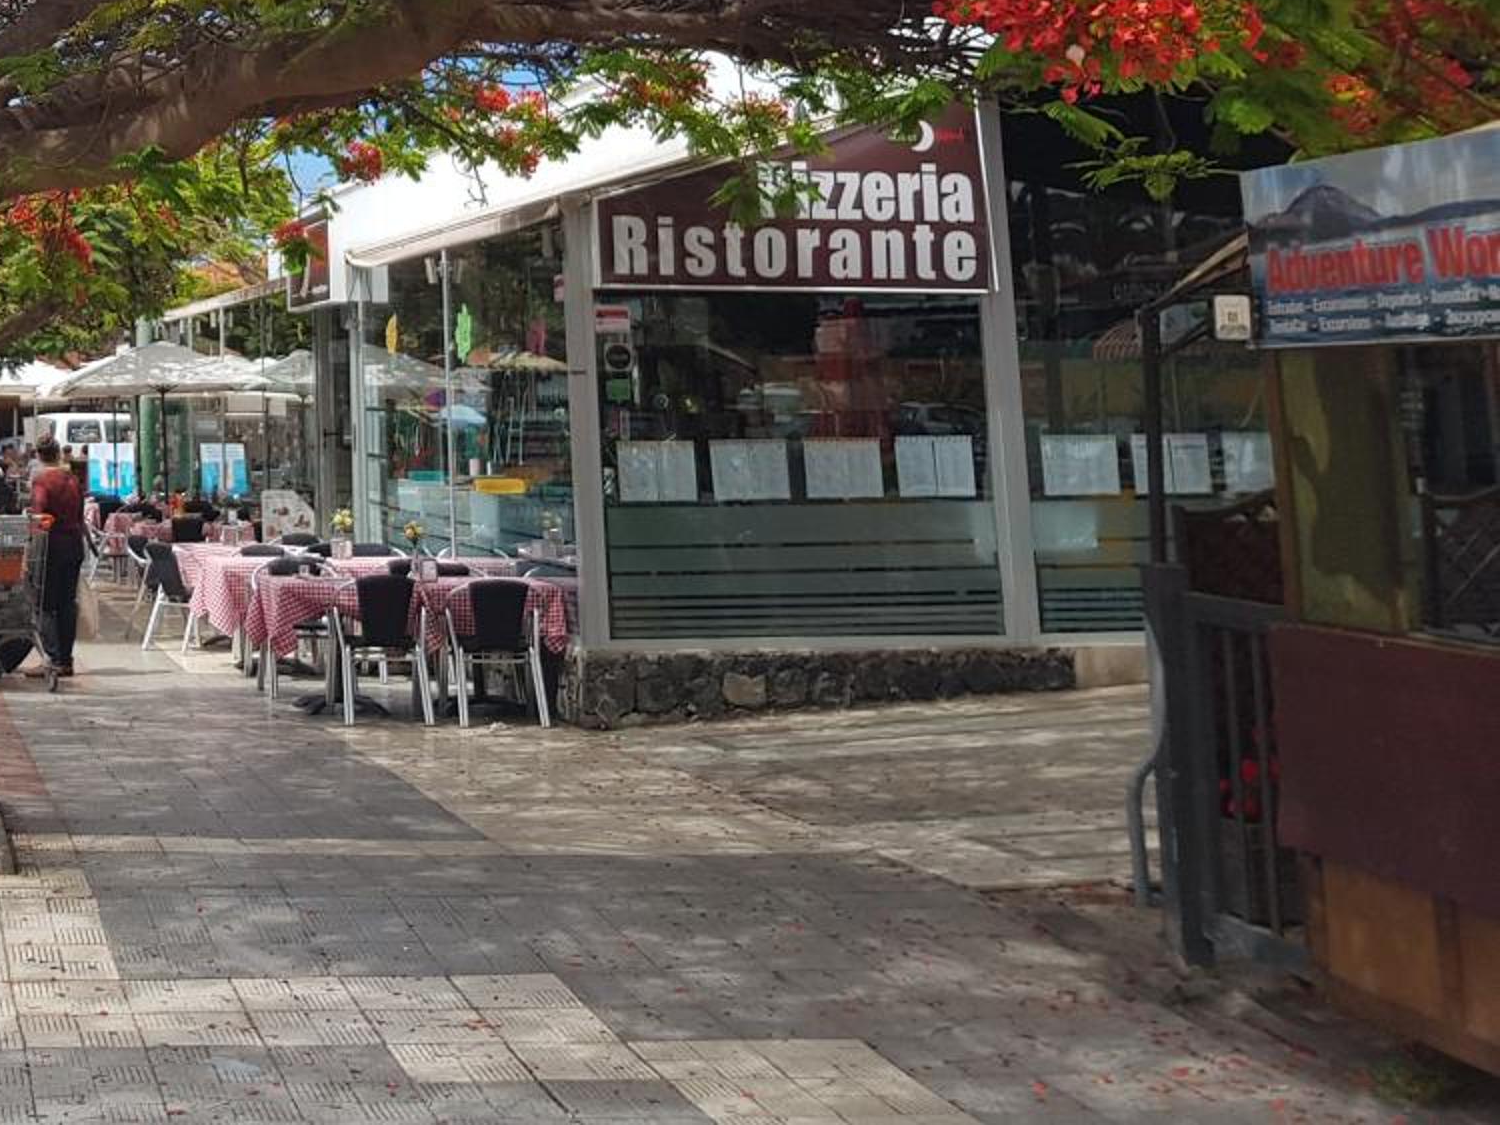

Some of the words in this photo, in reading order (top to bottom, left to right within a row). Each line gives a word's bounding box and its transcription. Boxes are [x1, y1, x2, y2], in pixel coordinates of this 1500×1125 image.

[756, 160, 975, 222] Pizzeria
[611, 214, 978, 282] Ristorante
[1266, 237, 1426, 294] Adventure
